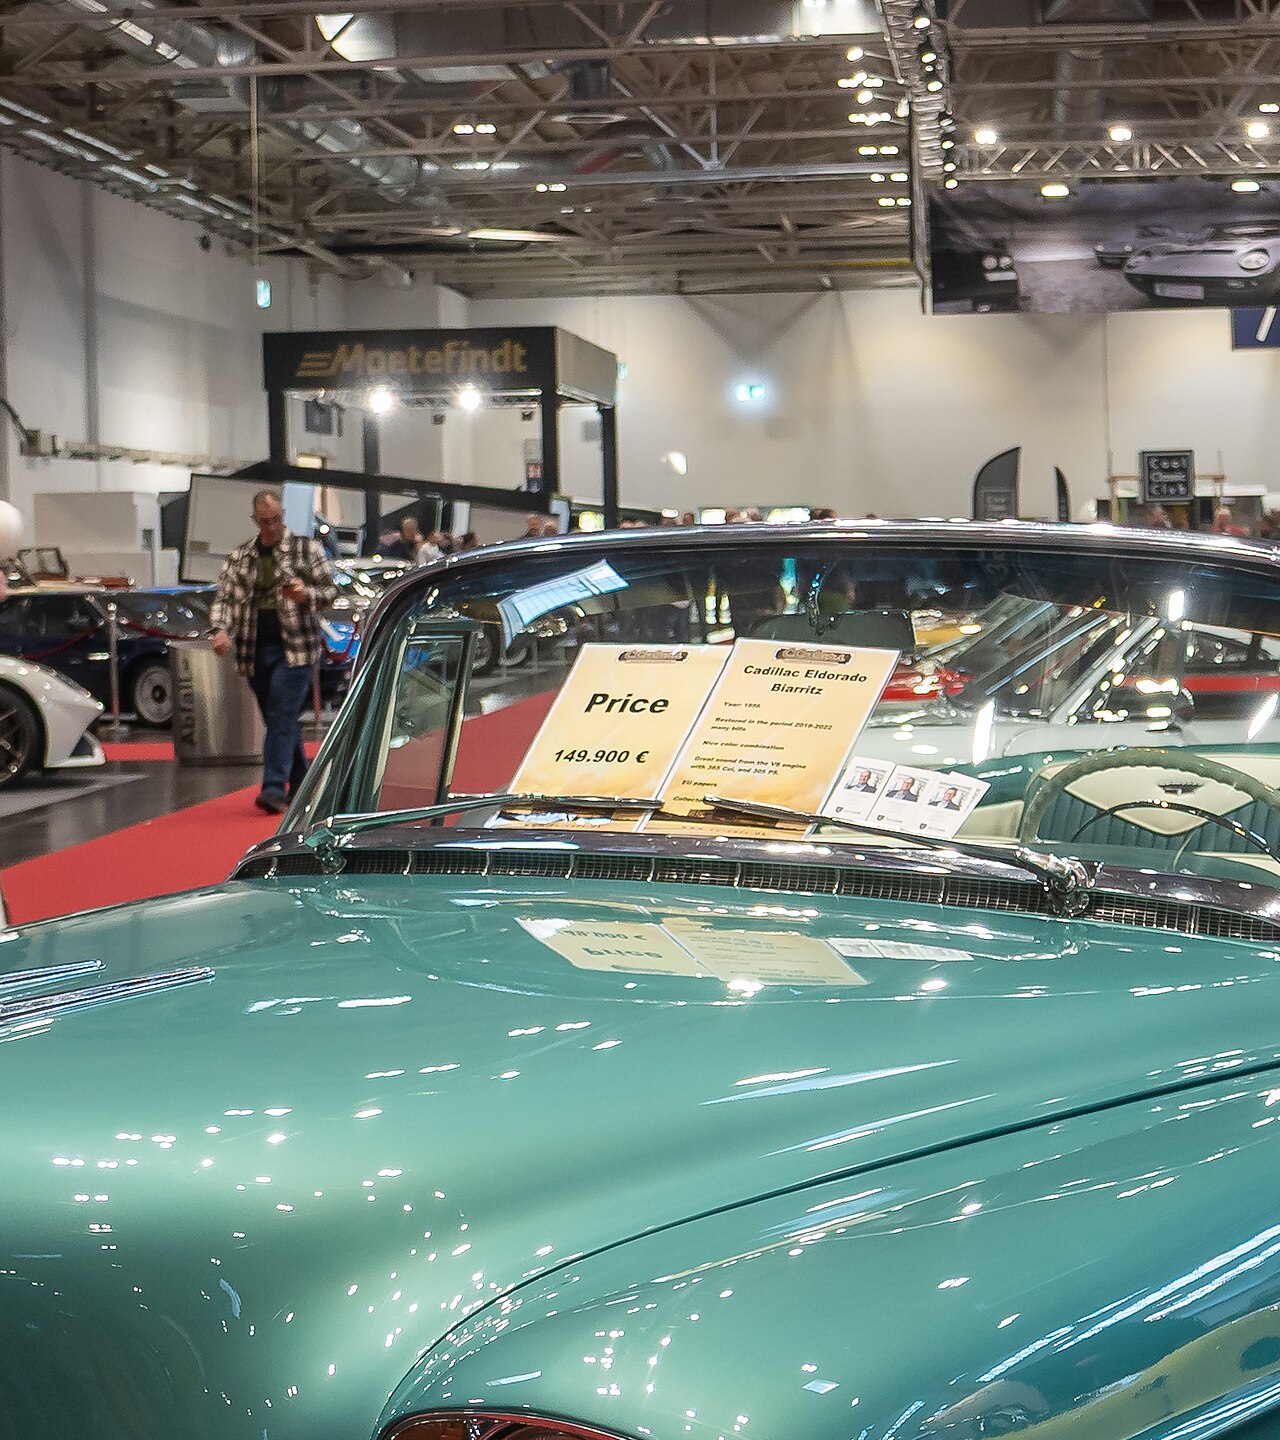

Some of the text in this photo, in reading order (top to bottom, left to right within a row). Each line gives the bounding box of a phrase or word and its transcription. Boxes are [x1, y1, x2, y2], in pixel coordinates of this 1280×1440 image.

[743, 665, 868, 683] Cadillac Eldorado
[770, 683, 824, 696] Biarritz
[584, 693, 669, 714] Price
[715, 716, 748, 724] Restored
[740, 742, 785, 751] combination
[554, 750, 650, 764] 149.900 €
[693, 780, 718, 788] papers
